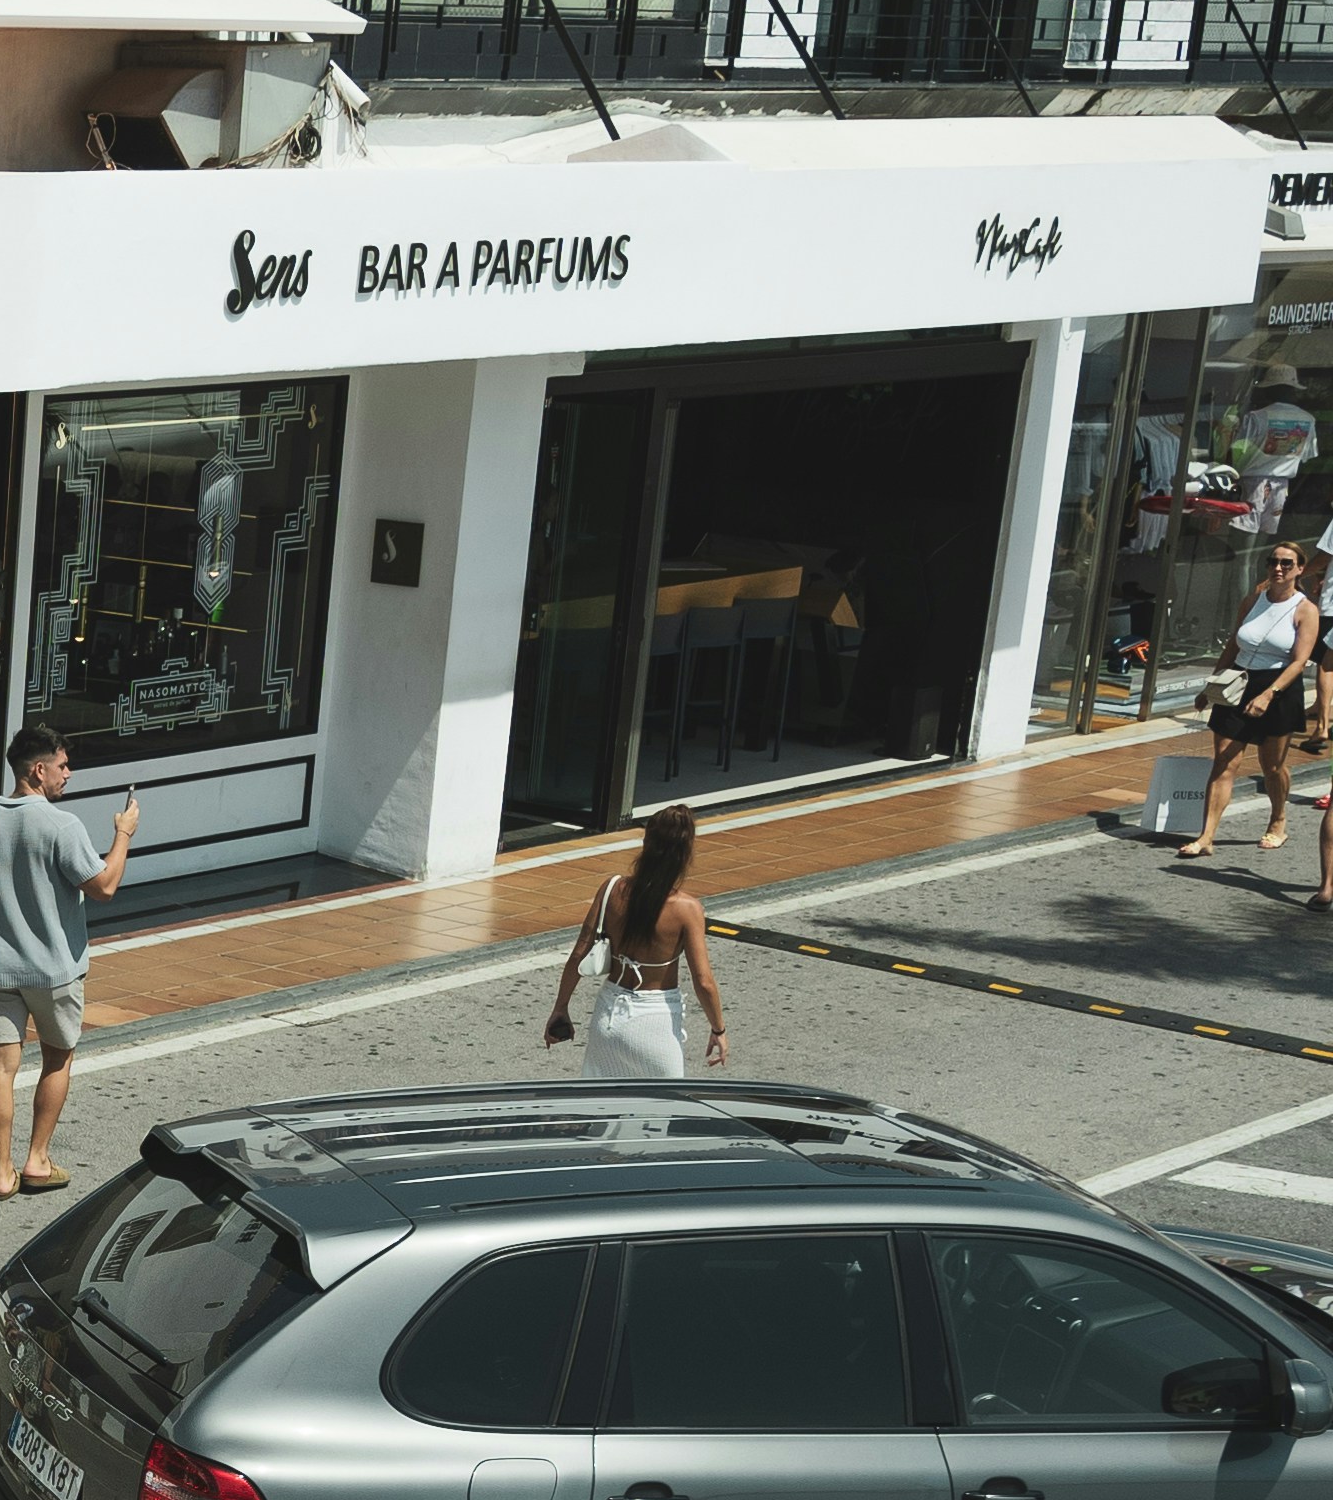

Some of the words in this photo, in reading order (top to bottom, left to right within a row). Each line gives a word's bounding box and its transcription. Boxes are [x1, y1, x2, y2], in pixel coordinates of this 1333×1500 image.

[226, 229, 313, 315] Sens
[357, 242, 429, 294] BAR
[435, 241, 460, 289] A
[471, 234, 631, 287] PARFUMS
[139, 681, 206, 701] NASOMATTO
[1172, 790, 1205, 800] GUESS
[9, 1360, 43, 1400] Cayenne
[43, 1394, 73, 1422] GTS
[16, 1421, 49, 1474] 3085
[47, 1452, 79, 1500] KBT
